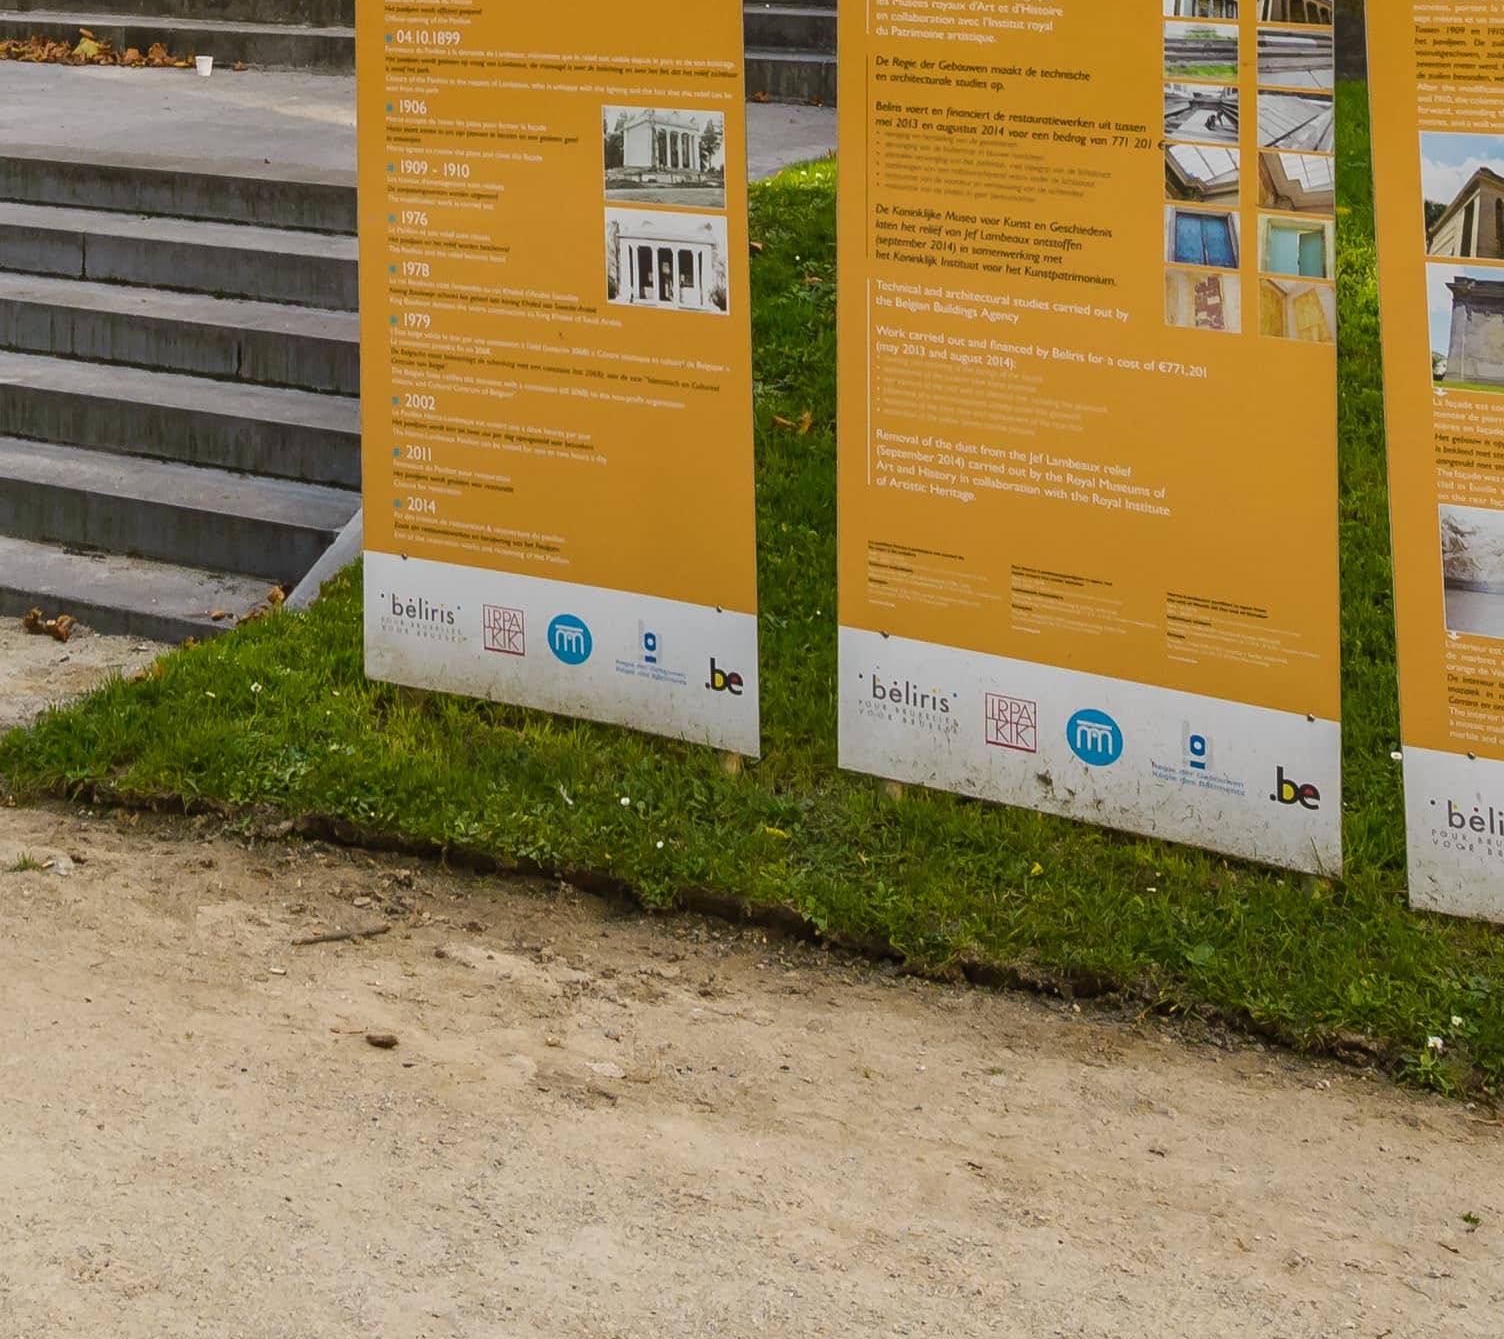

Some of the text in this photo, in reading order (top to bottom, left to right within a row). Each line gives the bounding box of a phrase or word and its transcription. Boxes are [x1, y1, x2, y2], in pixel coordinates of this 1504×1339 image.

[396, 28, 460, 45] 04.10.1899
[875, 25, 889, 36] du
[399, 99, 427, 115] 1906
[399, 158, 428, 175] 1909
[443, 162, 470, 178] 1910
[401, 209, 428, 226] 1976
[874, 202, 1112, 238] De Koninklijke Musea voor Kunst en Geschiedenis
[402, 260, 430, 277] 1978
[874, 248, 890, 260] het
[892, 250, 937, 267] Koninklijk
[940, 255, 979, 270] Instituut
[981, 263, 1003, 273] voor
[1004, 263, 1021, 275] het
[875, 278, 1129, 323] Technical and architectural studies carried out by
[875, 294, 893, 306] the
[932, 300, 978, 319] Buildings
[979, 306, 1019, 325] Agency
[403, 312, 431, 328] 1979
[875, 324, 906, 338] Work
[907, 331, 945, 344] carried
[946, 336, 965, 346] out
[967, 338, 987, 349] and
[989, 338, 1033, 355] financed
[1035, 345, 1049, 359] by
[1051, 346, 1085, 362] Beliris
[1087, 351, 1104, 364] for
[1106, 356, 1114, 366] a
[1116, 357, 1140, 370] cost
[1142, 359, 1156, 371] of
[875, 340, 899, 355] (may
[902, 342, 925, 357] 2013
[927, 348, 948, 359] and
[949, 352, 983, 366] august
[404, 392, 435, 410] 2002
[405, 443, 432, 462] 2011
[875, 427, 919, 445] Removal
[920, 435, 932, 447] of
[934, 437, 952, 450] the
[954, 440, 977, 454] dust
[979, 443, 1006, 458] from
[1007, 449, 1026, 462] the
[1027, 451, 1043, 466] Jef
[1045, 453, 1100, 472] Lambeaux
[875, 443, 1166, 499] (September 2014) carried out by the Royal Museums of
[875, 475, 887, 486] of
[888, 476, 926, 493] Artistic
[875, 458, 1170, 516] Art and History in collaboration with the Royal Institute
[406, 495, 436, 514] 2014
[704, 656, 743, 696] .be
[1268, 765, 1320, 810] .be
